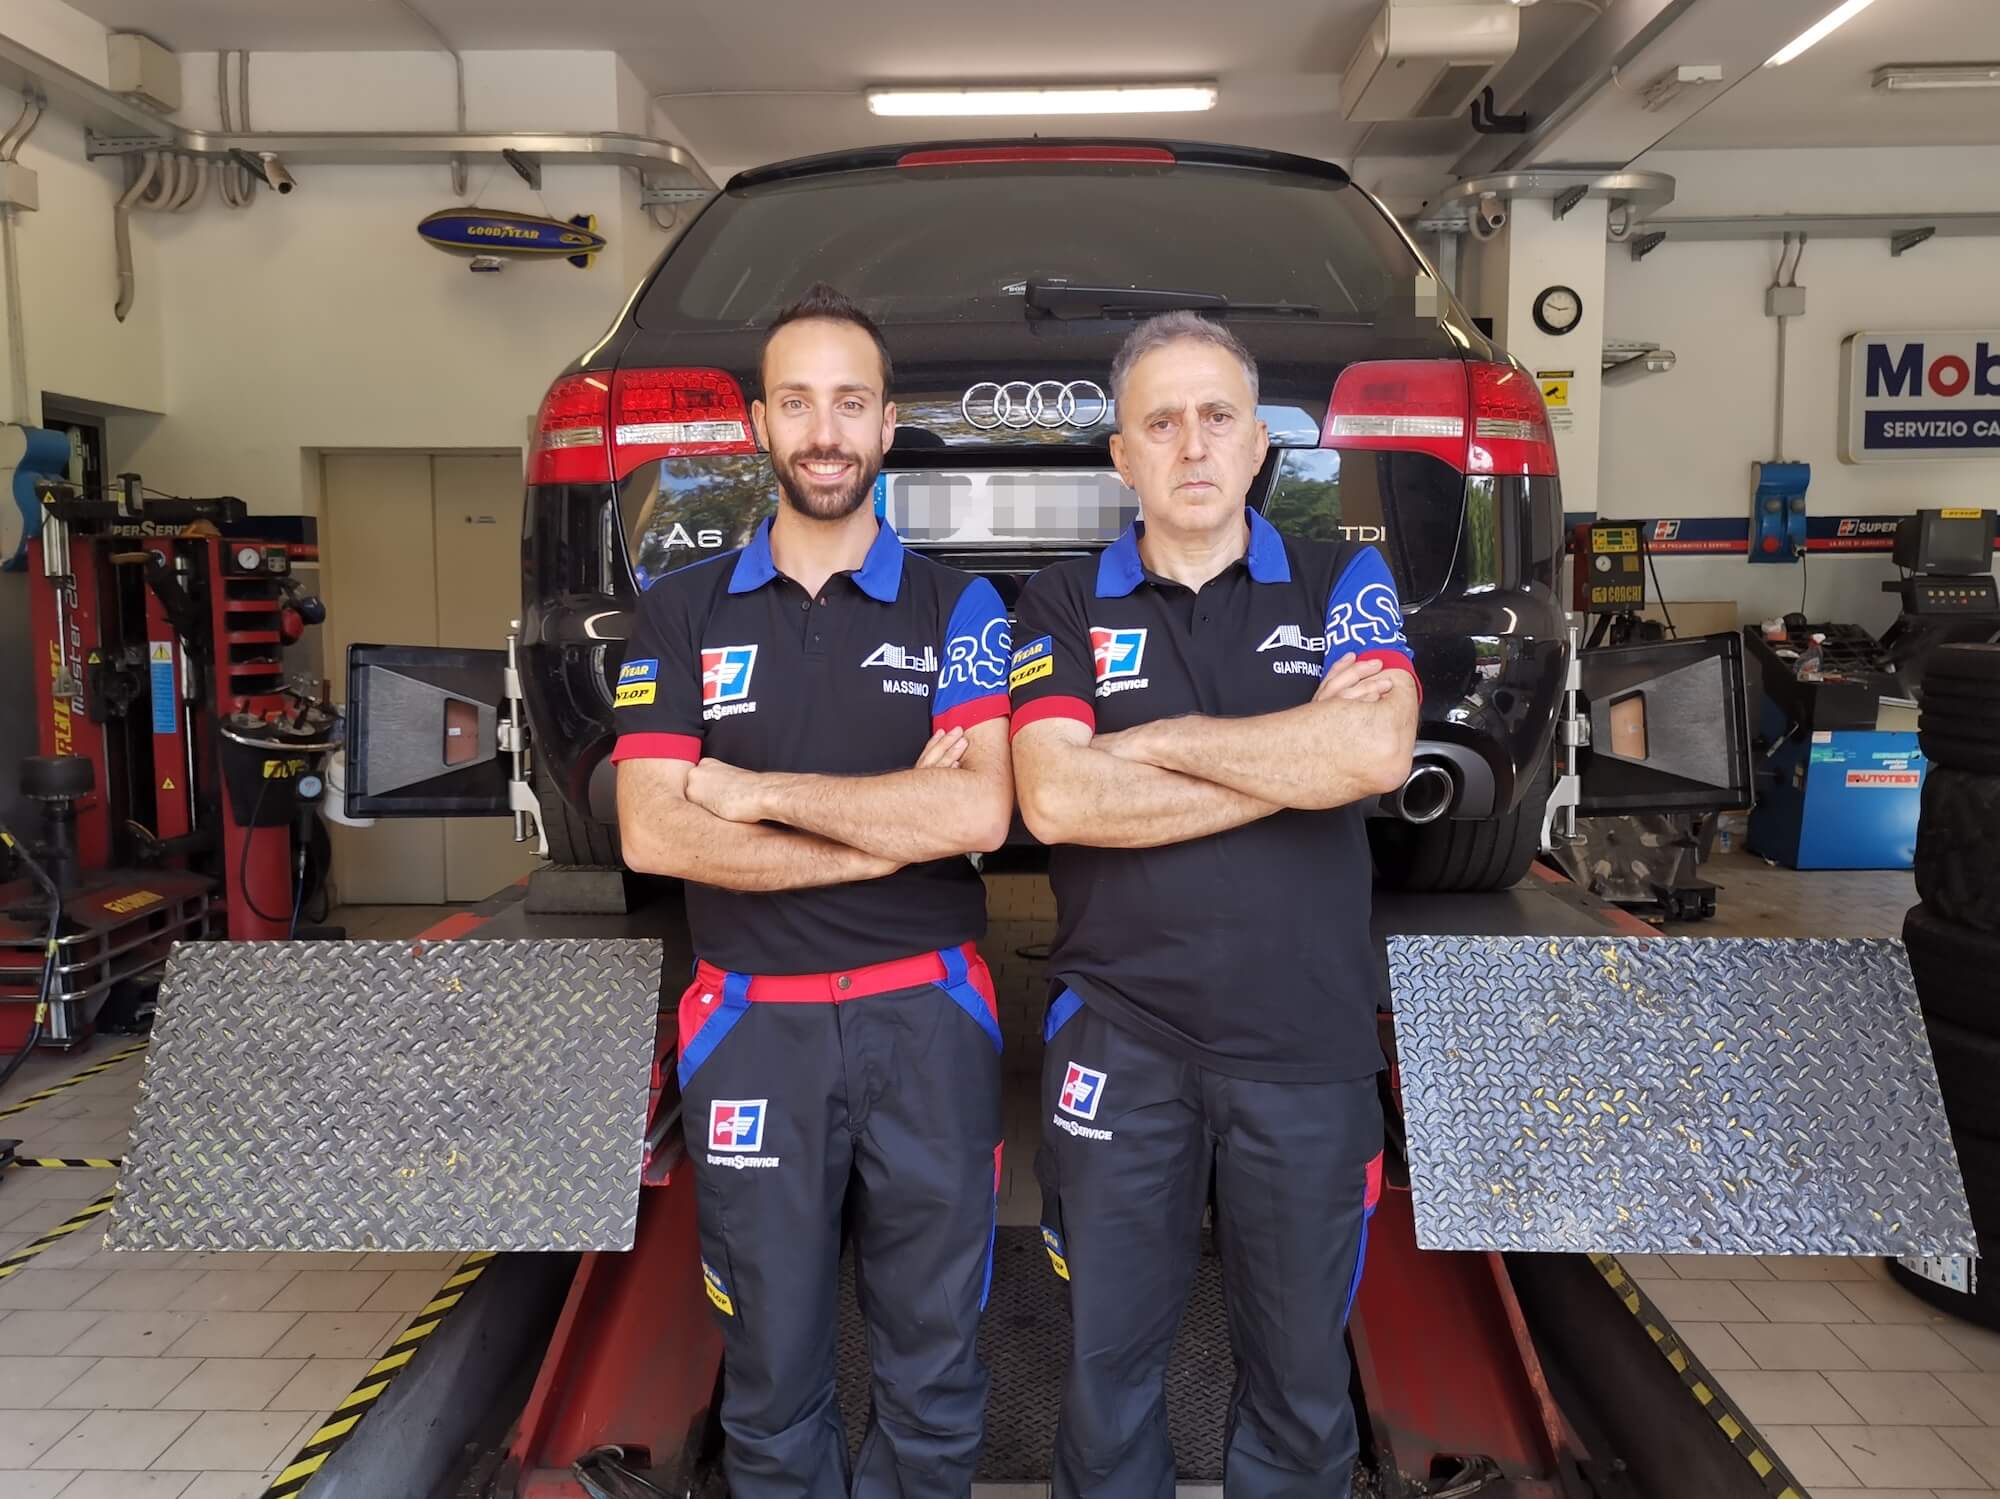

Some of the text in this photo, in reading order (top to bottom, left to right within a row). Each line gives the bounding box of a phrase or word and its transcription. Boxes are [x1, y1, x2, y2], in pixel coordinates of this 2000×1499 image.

[466, 225, 540, 240] GOODYEAR
[1882, 421, 1969, 438] SERVIZIO
[112, 520, 185, 537] PERSERV
[663, 522, 723, 549] A6
[1337, 525, 1387, 542] TDI
[1858, 521, 1899, 534] SUPER
[1256, 624, 1326, 653] Albe
[620, 664, 650, 680] YEAR
[1272, 660, 1323, 678] GIANFRANC
[616, 688, 650, 700] NLOP
[882, 679, 929, 697] MASSIMO
[703, 702, 757, 721] ERSERVICE
